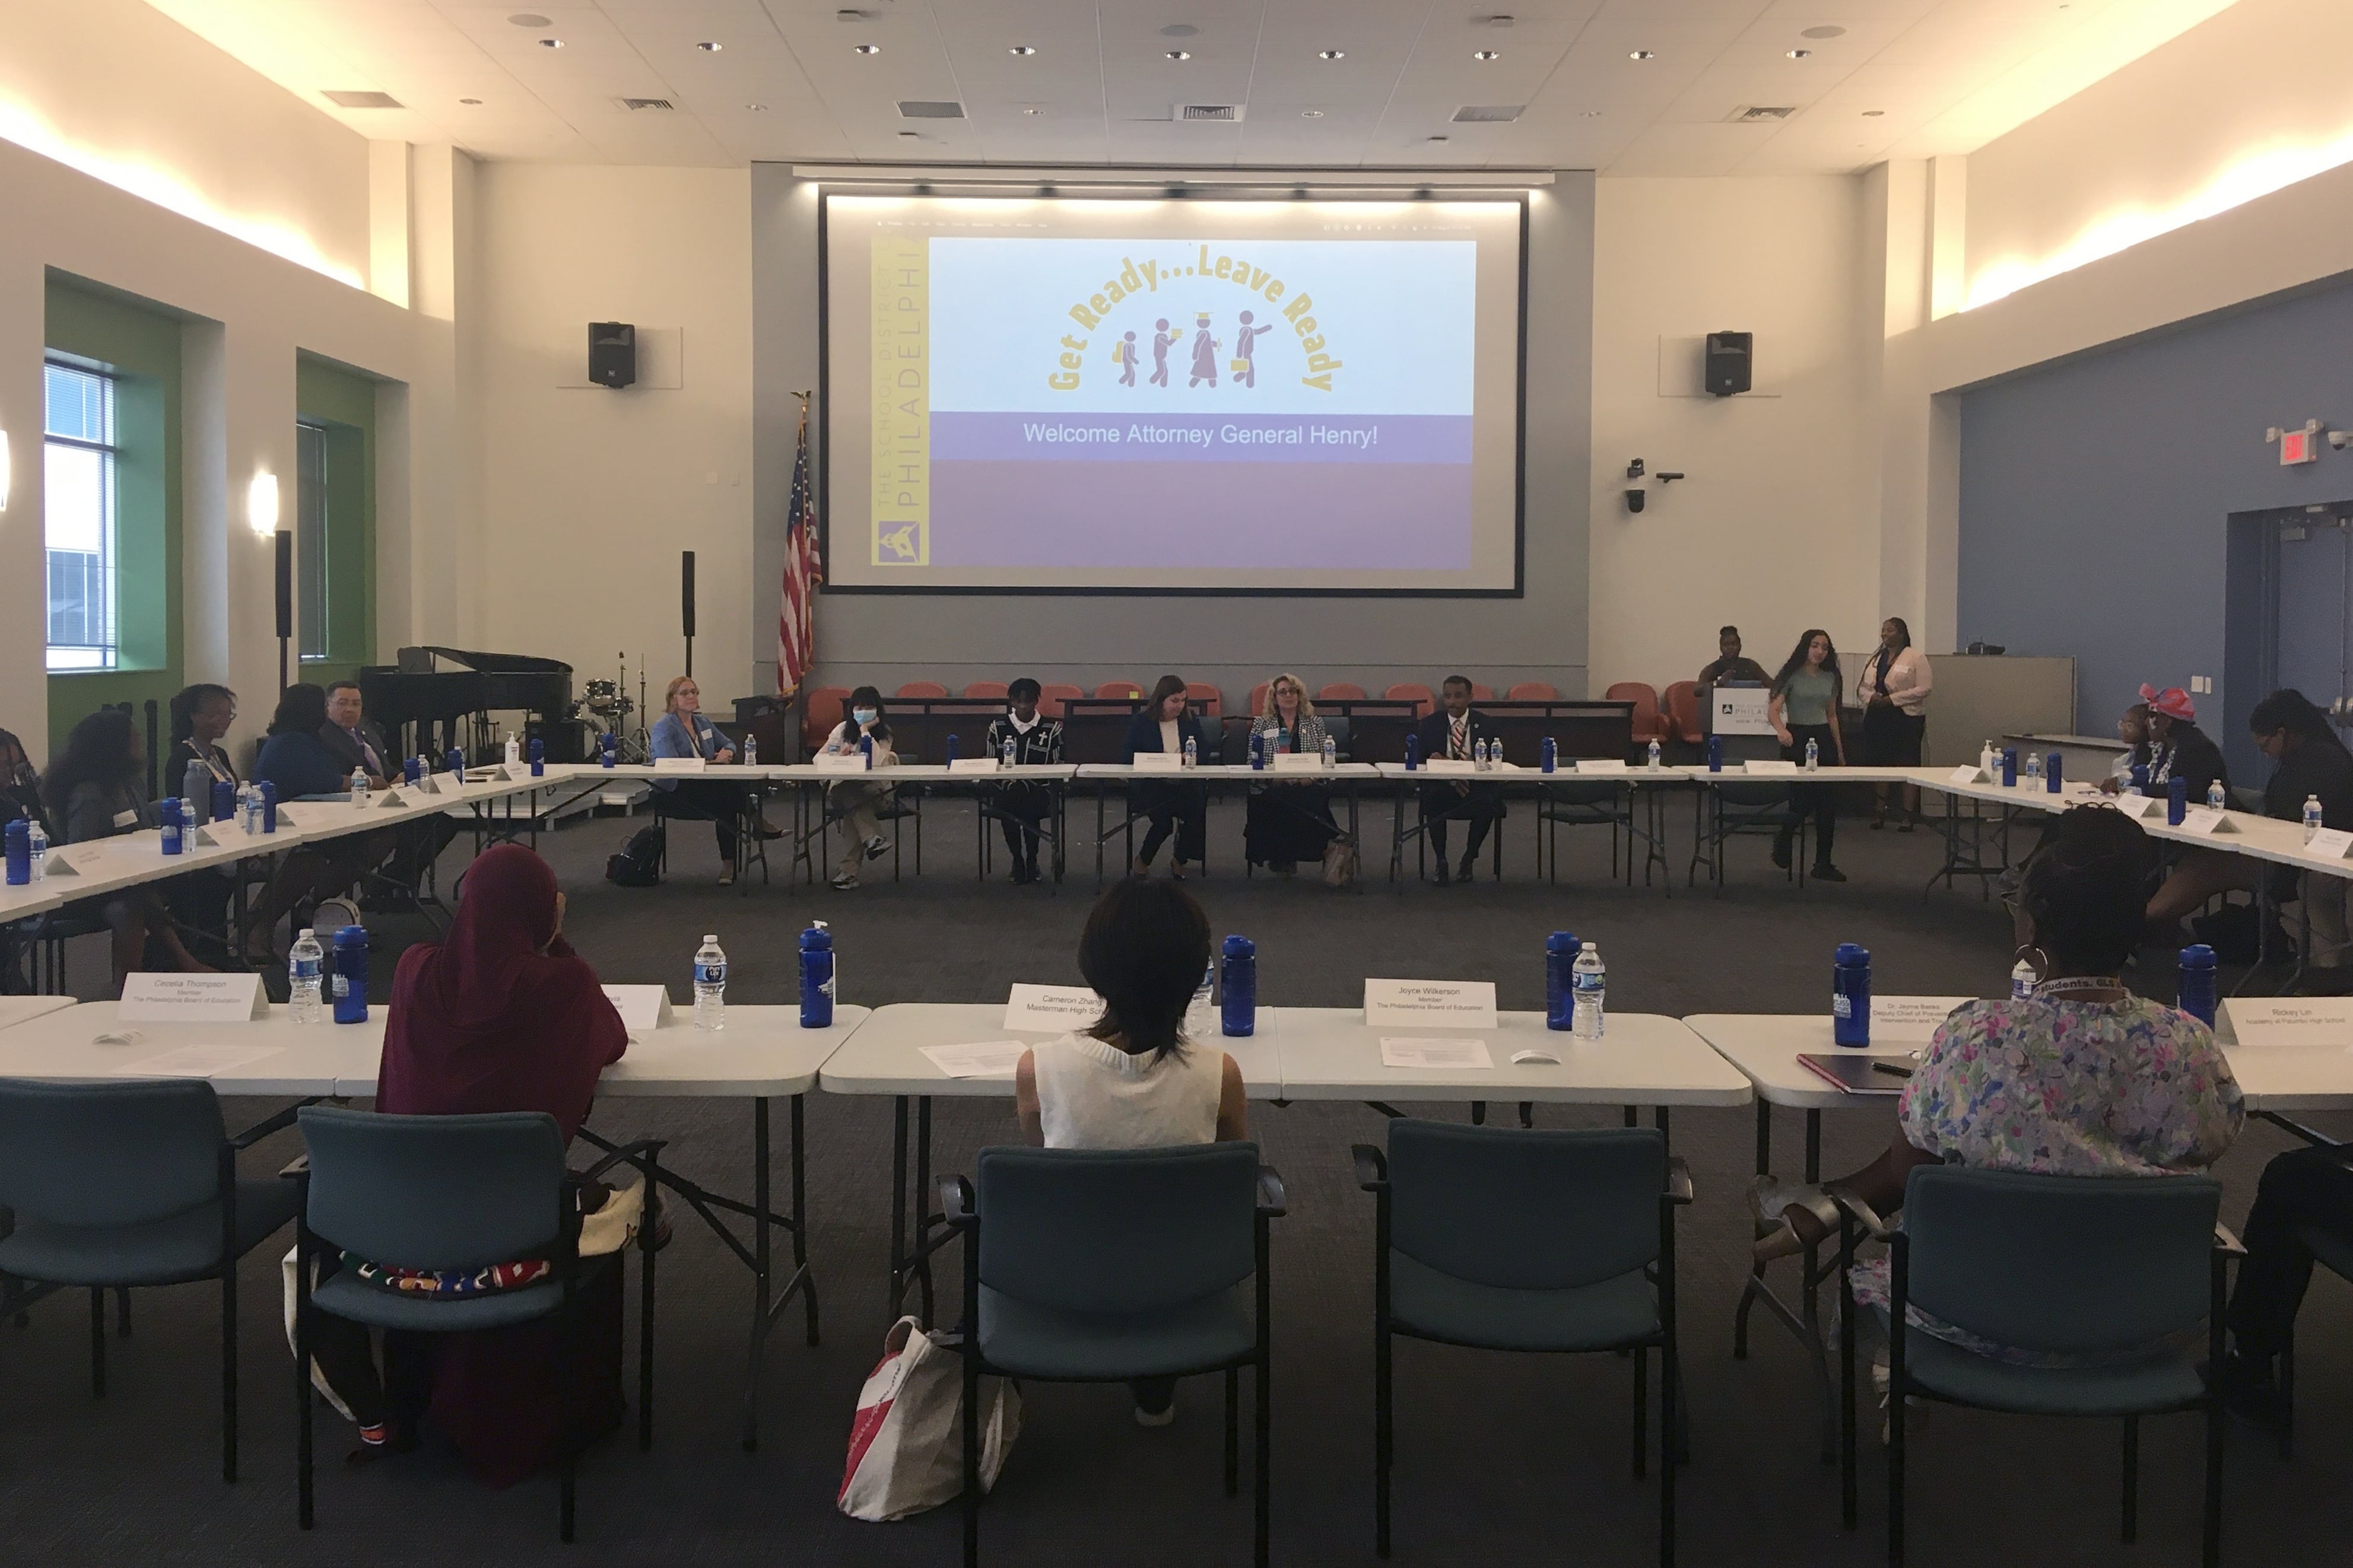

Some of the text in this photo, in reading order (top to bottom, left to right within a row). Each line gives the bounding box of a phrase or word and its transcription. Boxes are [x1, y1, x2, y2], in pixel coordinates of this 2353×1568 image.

[878, 265, 891, 361] DISTRICT
[1048, 334, 1088, 390] Get
[1282, 292, 1343, 392] Ready
[878, 373, 891, 458] SCHOOL
[1024, 424, 1377, 449] Welcome Attorney General Henry!
[878, 470, 891, 507] THE
[187, 980, 227, 989] Thompson
[1027, 1003, 1068, 1013] Masterman
[1070, 1006, 1087, 1015] High
[1042, 995, 1102, 1006] Cameron Zhang
